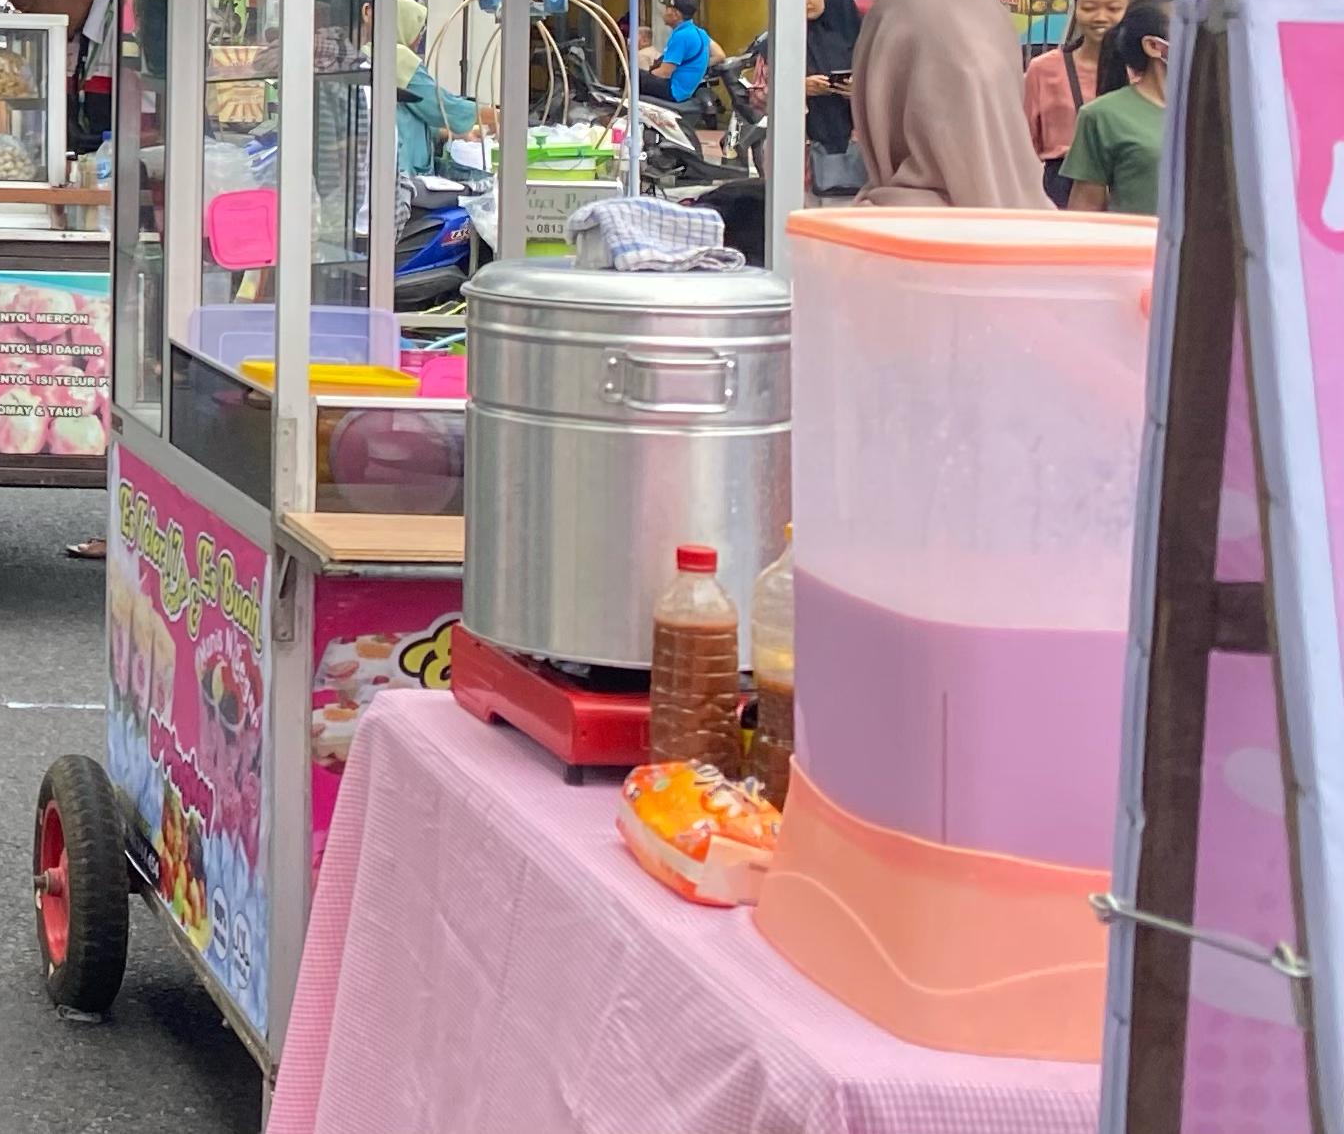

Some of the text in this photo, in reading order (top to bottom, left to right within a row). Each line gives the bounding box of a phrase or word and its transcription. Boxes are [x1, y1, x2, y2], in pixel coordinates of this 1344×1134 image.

[36, 313, 89, 324] MERCON
[36, 344, 52, 355] ISI
[55, 345, 103, 356] DAGING
[36, 375, 52, 385] ISI
[55, 375, 96, 386] TELUR
[35, 405, 45, 416] &
[48, 406, 82, 417] TAHU
[217, 550, 263, 658] Buah
